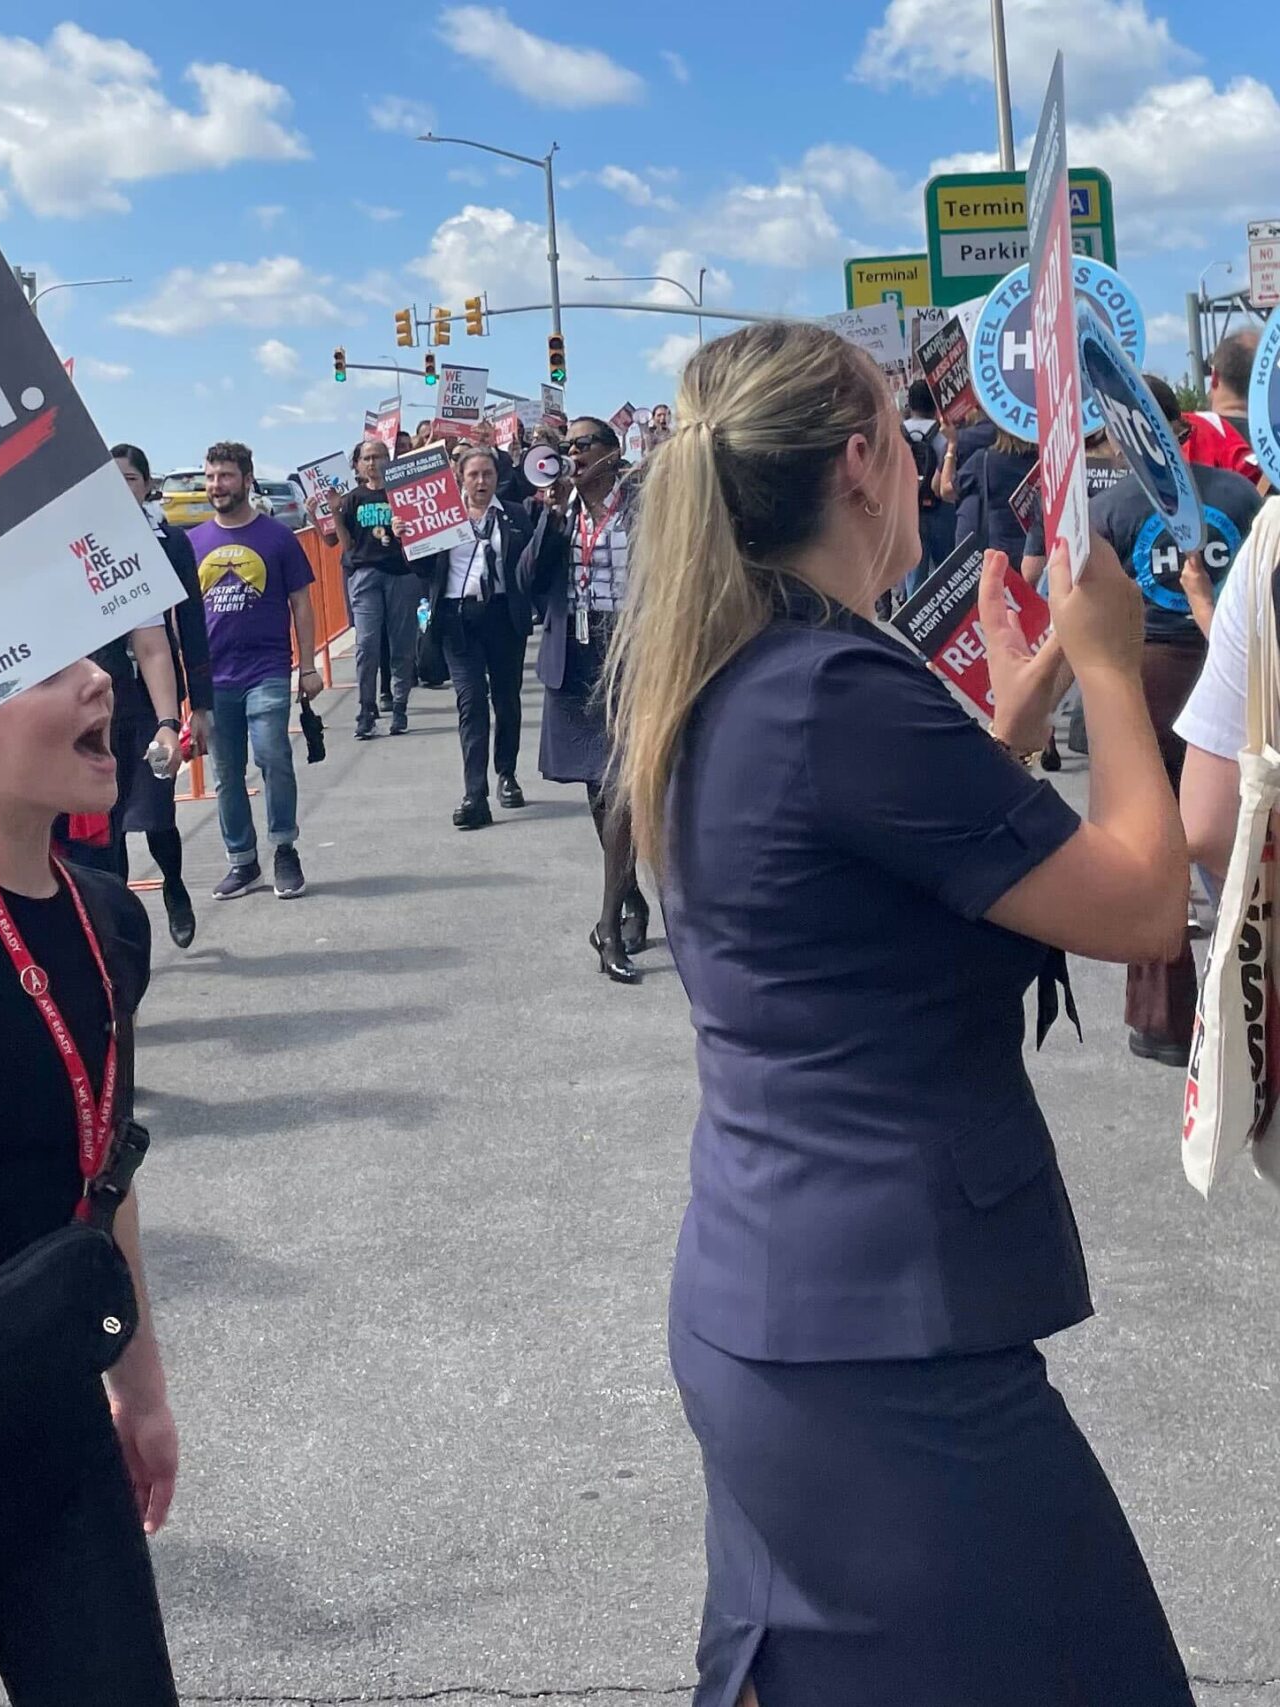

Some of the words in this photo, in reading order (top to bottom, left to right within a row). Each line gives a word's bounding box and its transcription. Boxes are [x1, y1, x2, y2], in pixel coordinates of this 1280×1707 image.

[944, 198, 1026, 217] Termin
[1260, 247, 1273, 260] NO
[857, 267, 918, 284] Terminal
[917, 308, 945, 320] WGA
[1034, 224, 1063, 375] READY
[923, 330, 945, 362] MORE
[938, 326, 961, 358] WORK
[979, 318, 1005, 402] HOTEL
[445, 370, 461, 382] WE
[445, 383, 465, 395] ARE
[1046, 333, 1060, 420] TO
[443, 394, 479, 407] READY
[1095, 389, 1166, 466] HTC
[1043, 372, 1076, 516] STRIKE
[304, 465, 324, 480] WE
[392, 477, 447, 508] READY
[413, 498, 437, 517] TO
[403, 506, 464, 537] STRIKE
[69, 533, 100, 559] WE
[1151, 541, 1230, 574] HC
[83, 547, 115, 577] ARE
[88, 553, 141, 595] READY
[100, 582, 151, 615] apfa.org
[213, 594, 245, 604] TAKING
[907, 587, 950, 633] AMERICAN
[947, 550, 983, 590] AIRLINES
[913, 611, 944, 643] FLIGHT
[943, 564, 984, 618] ATTENDANT
[213, 603, 245, 613] FLIGHT
[0, 918, 22, 952] READY
[39, 999, 56, 1019] ARE
[52, 1019, 73, 1055] READY
